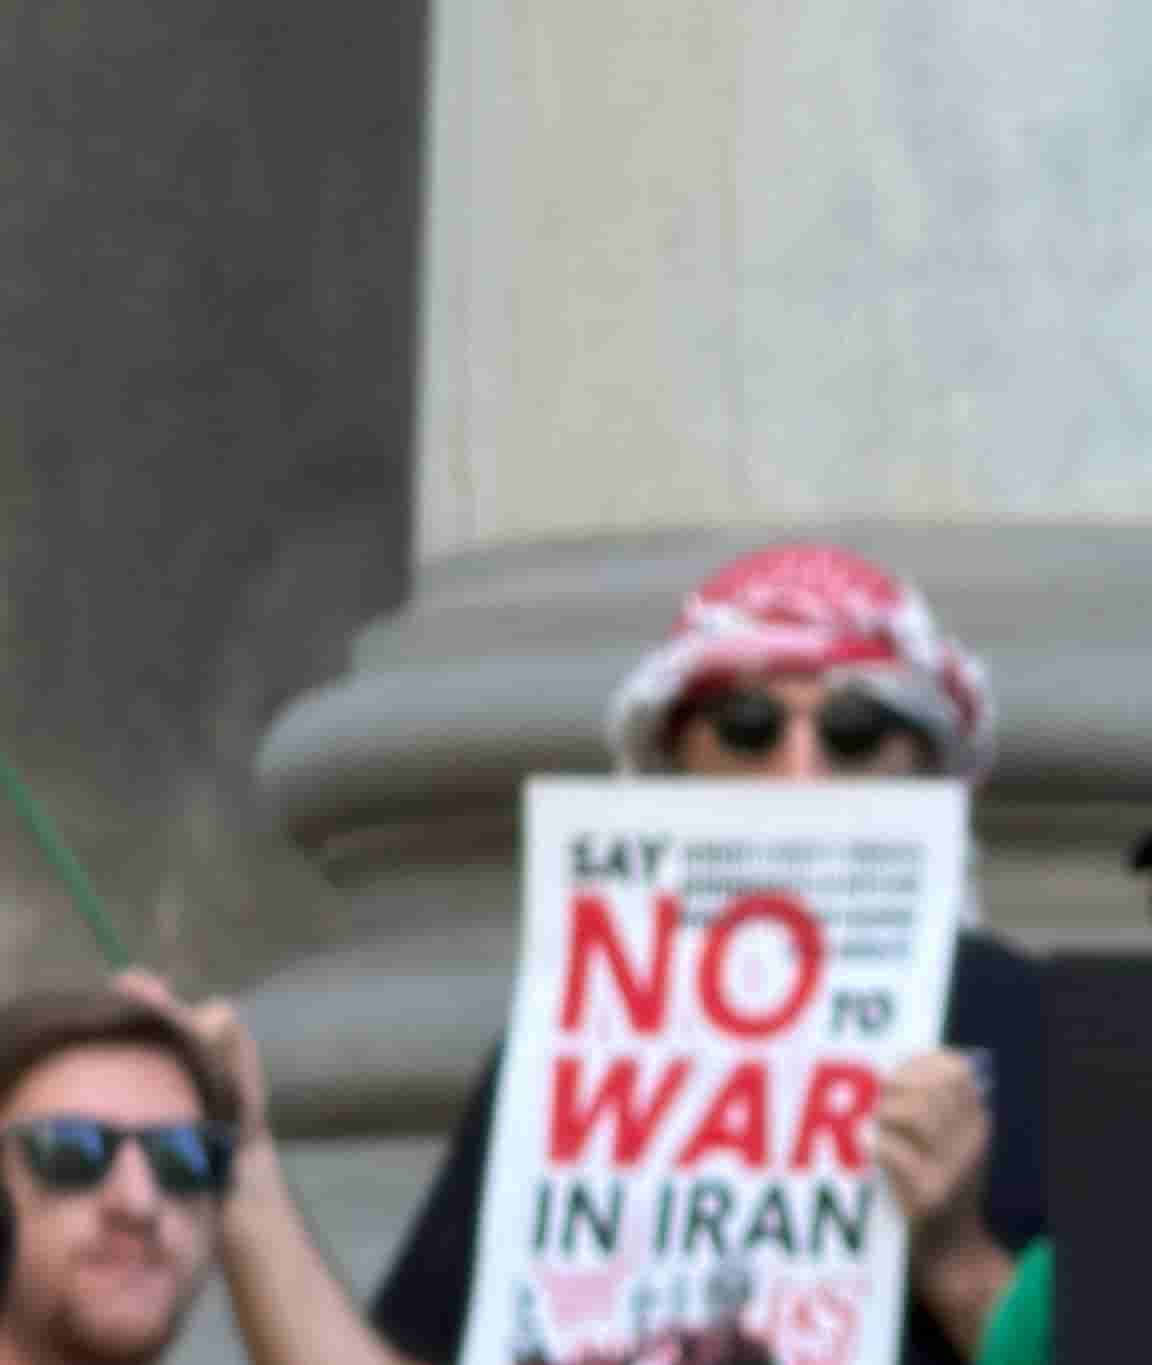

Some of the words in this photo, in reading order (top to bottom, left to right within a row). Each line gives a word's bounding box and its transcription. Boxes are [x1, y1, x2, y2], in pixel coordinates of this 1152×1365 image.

[567, 835, 672, 880] SAY
[560, 888, 826, 1040] NO
[830, 990, 893, 1037] TO
[545, 1055, 885, 1172] WAR
[532, 1178, 622, 1256] IN
[655, 1178, 869, 1256] IRAN
